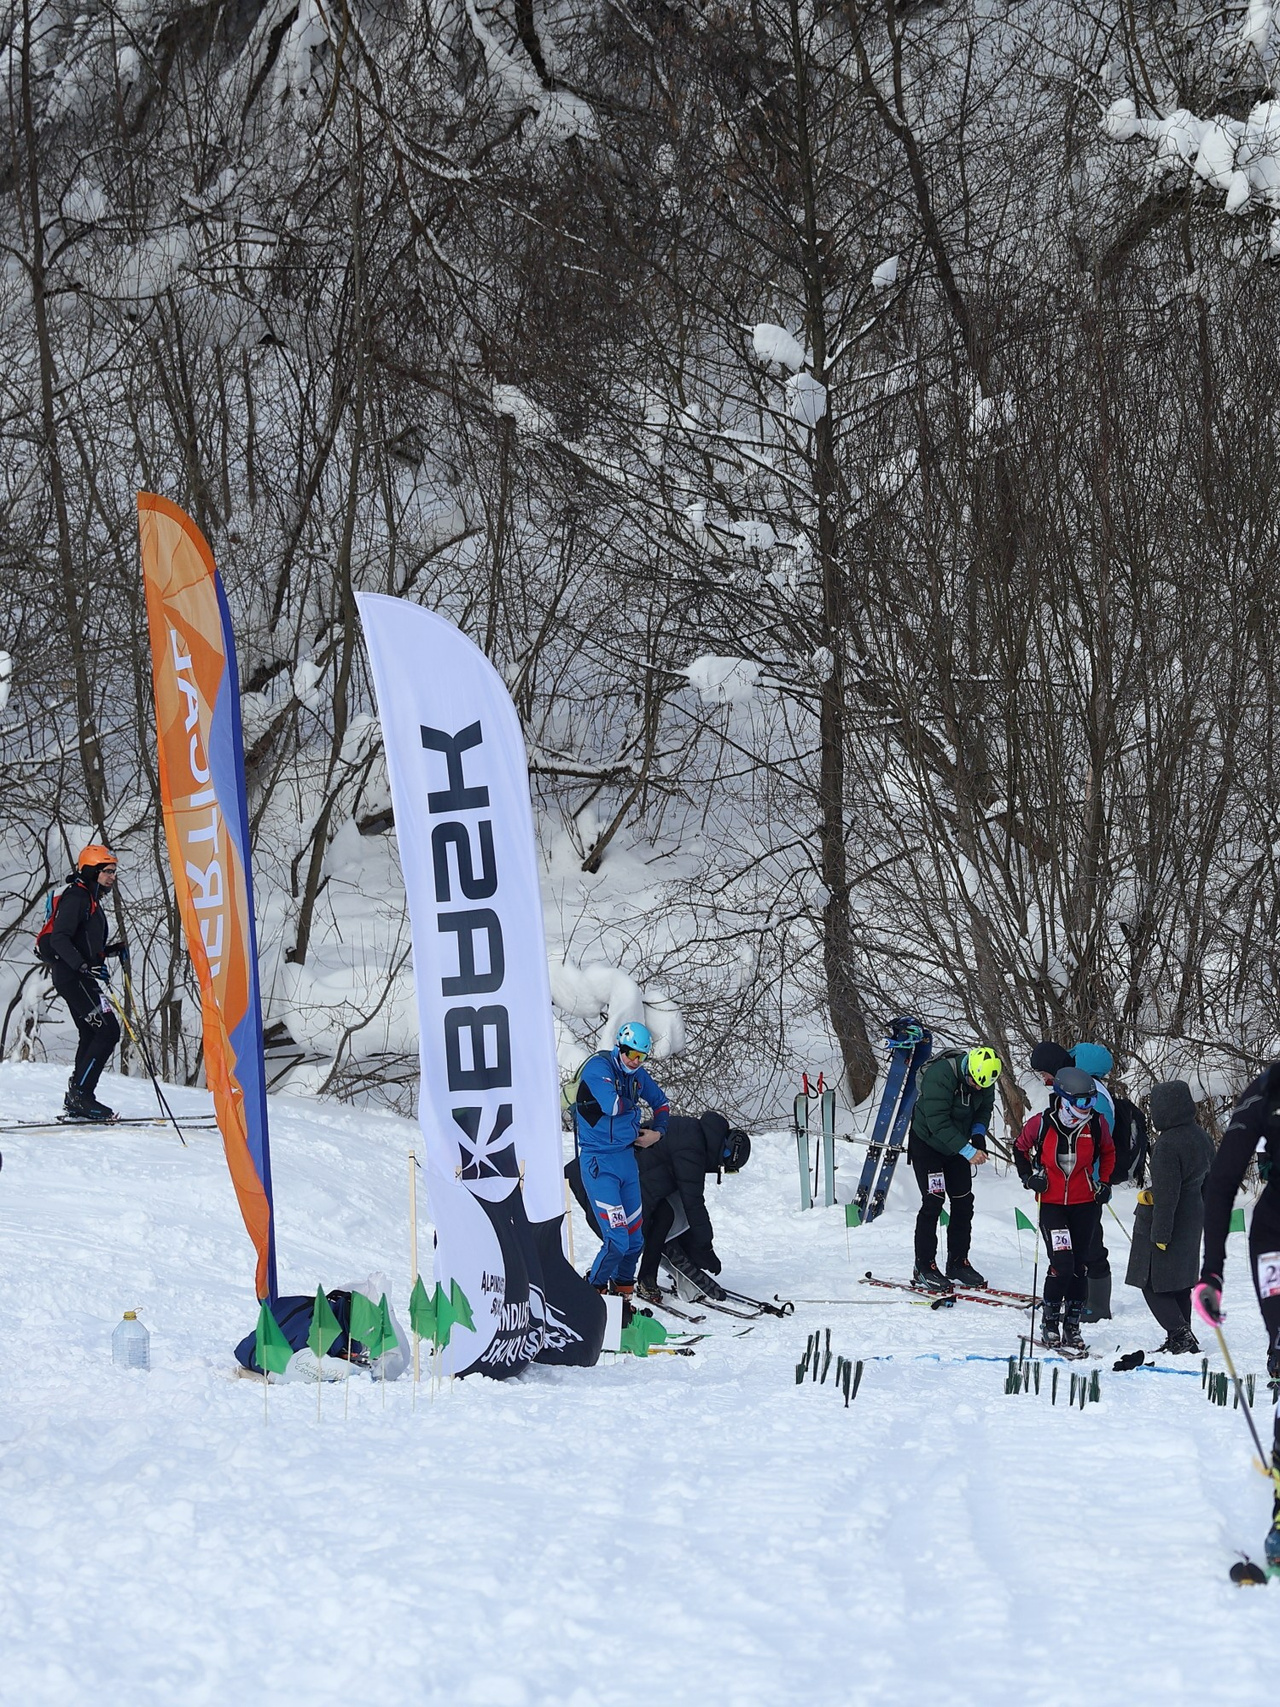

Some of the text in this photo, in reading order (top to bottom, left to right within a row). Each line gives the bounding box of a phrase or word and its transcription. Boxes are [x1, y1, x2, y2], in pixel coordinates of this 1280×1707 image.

[931, 1178, 942, 1189] 34
[611, 1211, 624, 1223] 36
[1055, 1235, 1068, 1246] 26
